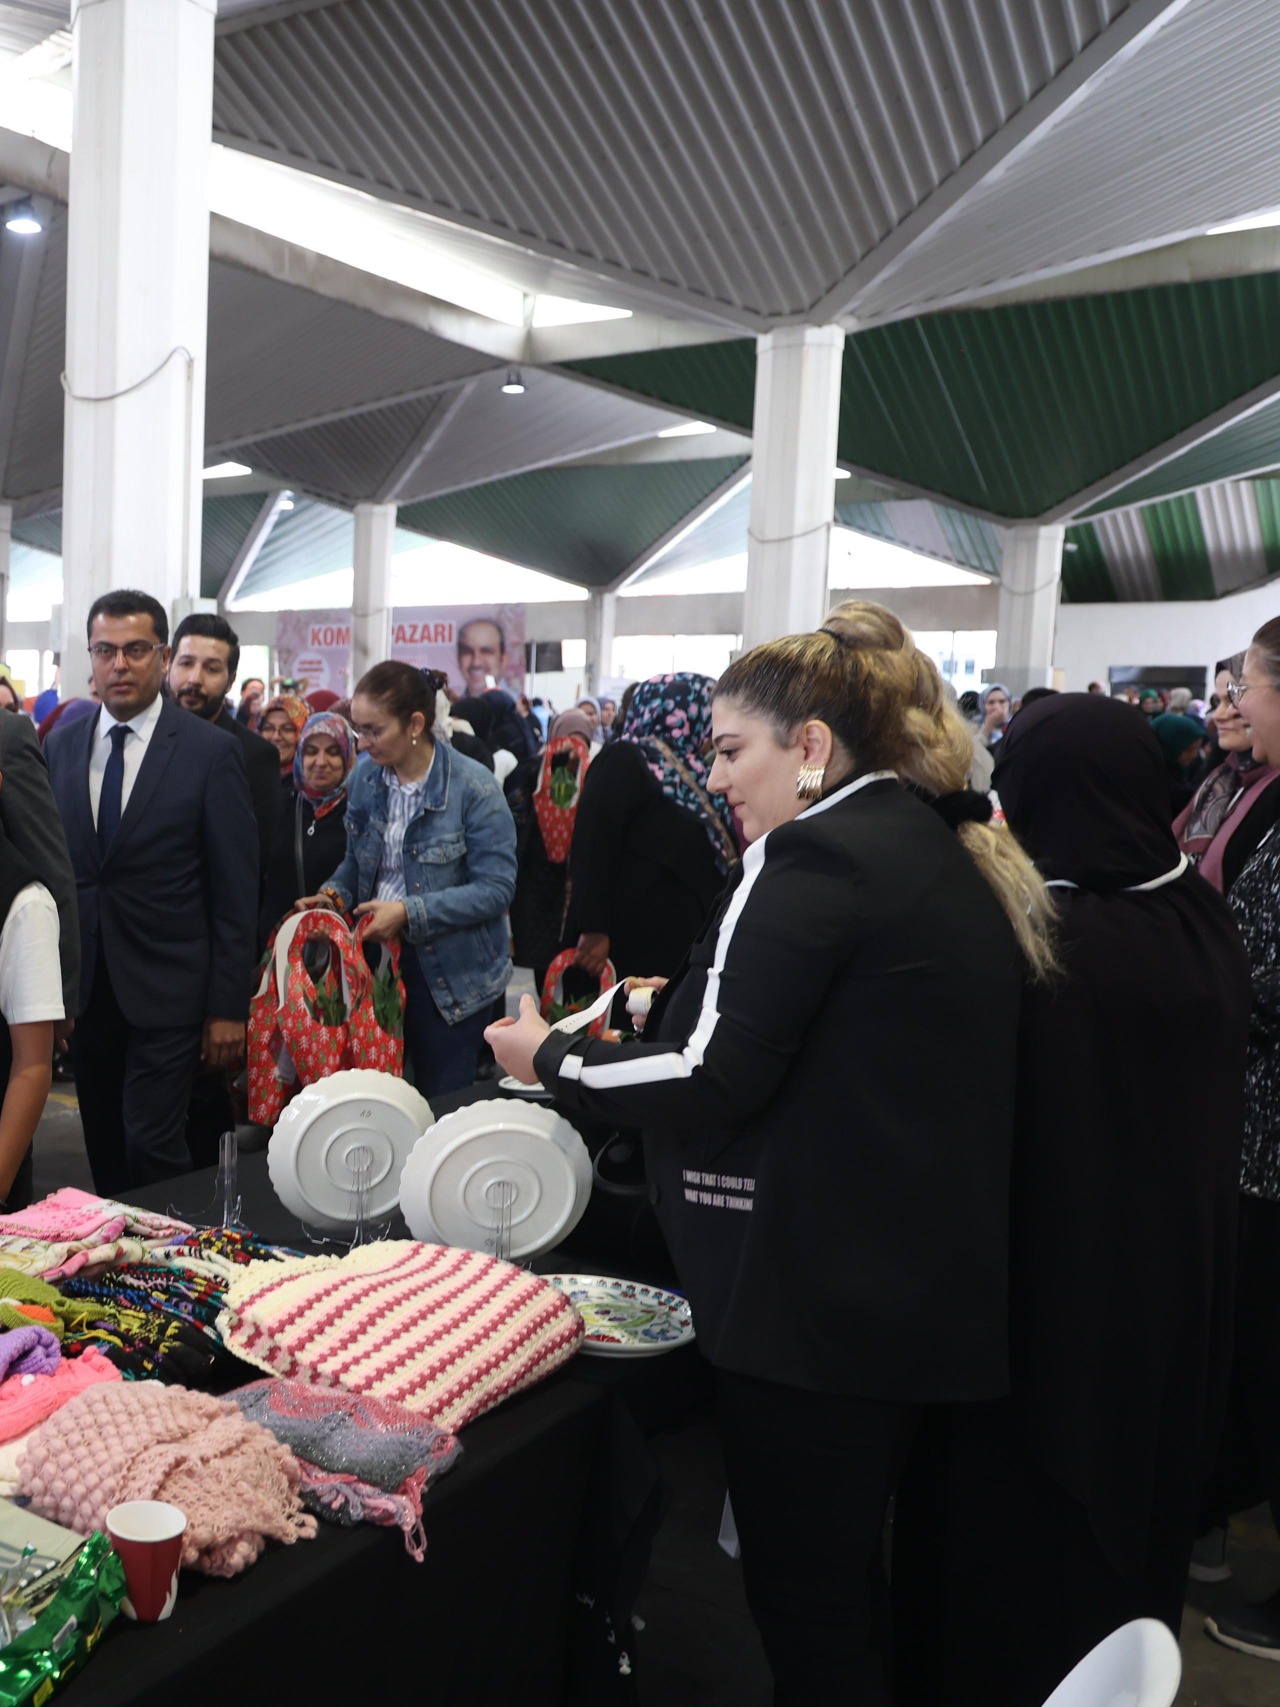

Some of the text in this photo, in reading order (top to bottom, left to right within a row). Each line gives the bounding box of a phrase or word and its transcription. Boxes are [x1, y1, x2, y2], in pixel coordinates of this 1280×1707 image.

[311, 623, 453, 646] KOM AZARI
[686, 1170, 701, 1184] WISH
[701, 1172, 717, 1187] THAT
[721, 1175, 742, 1190] COULD
[698, 1191, 712, 1206] YOU
[712, 1193, 725, 1207] ARE
